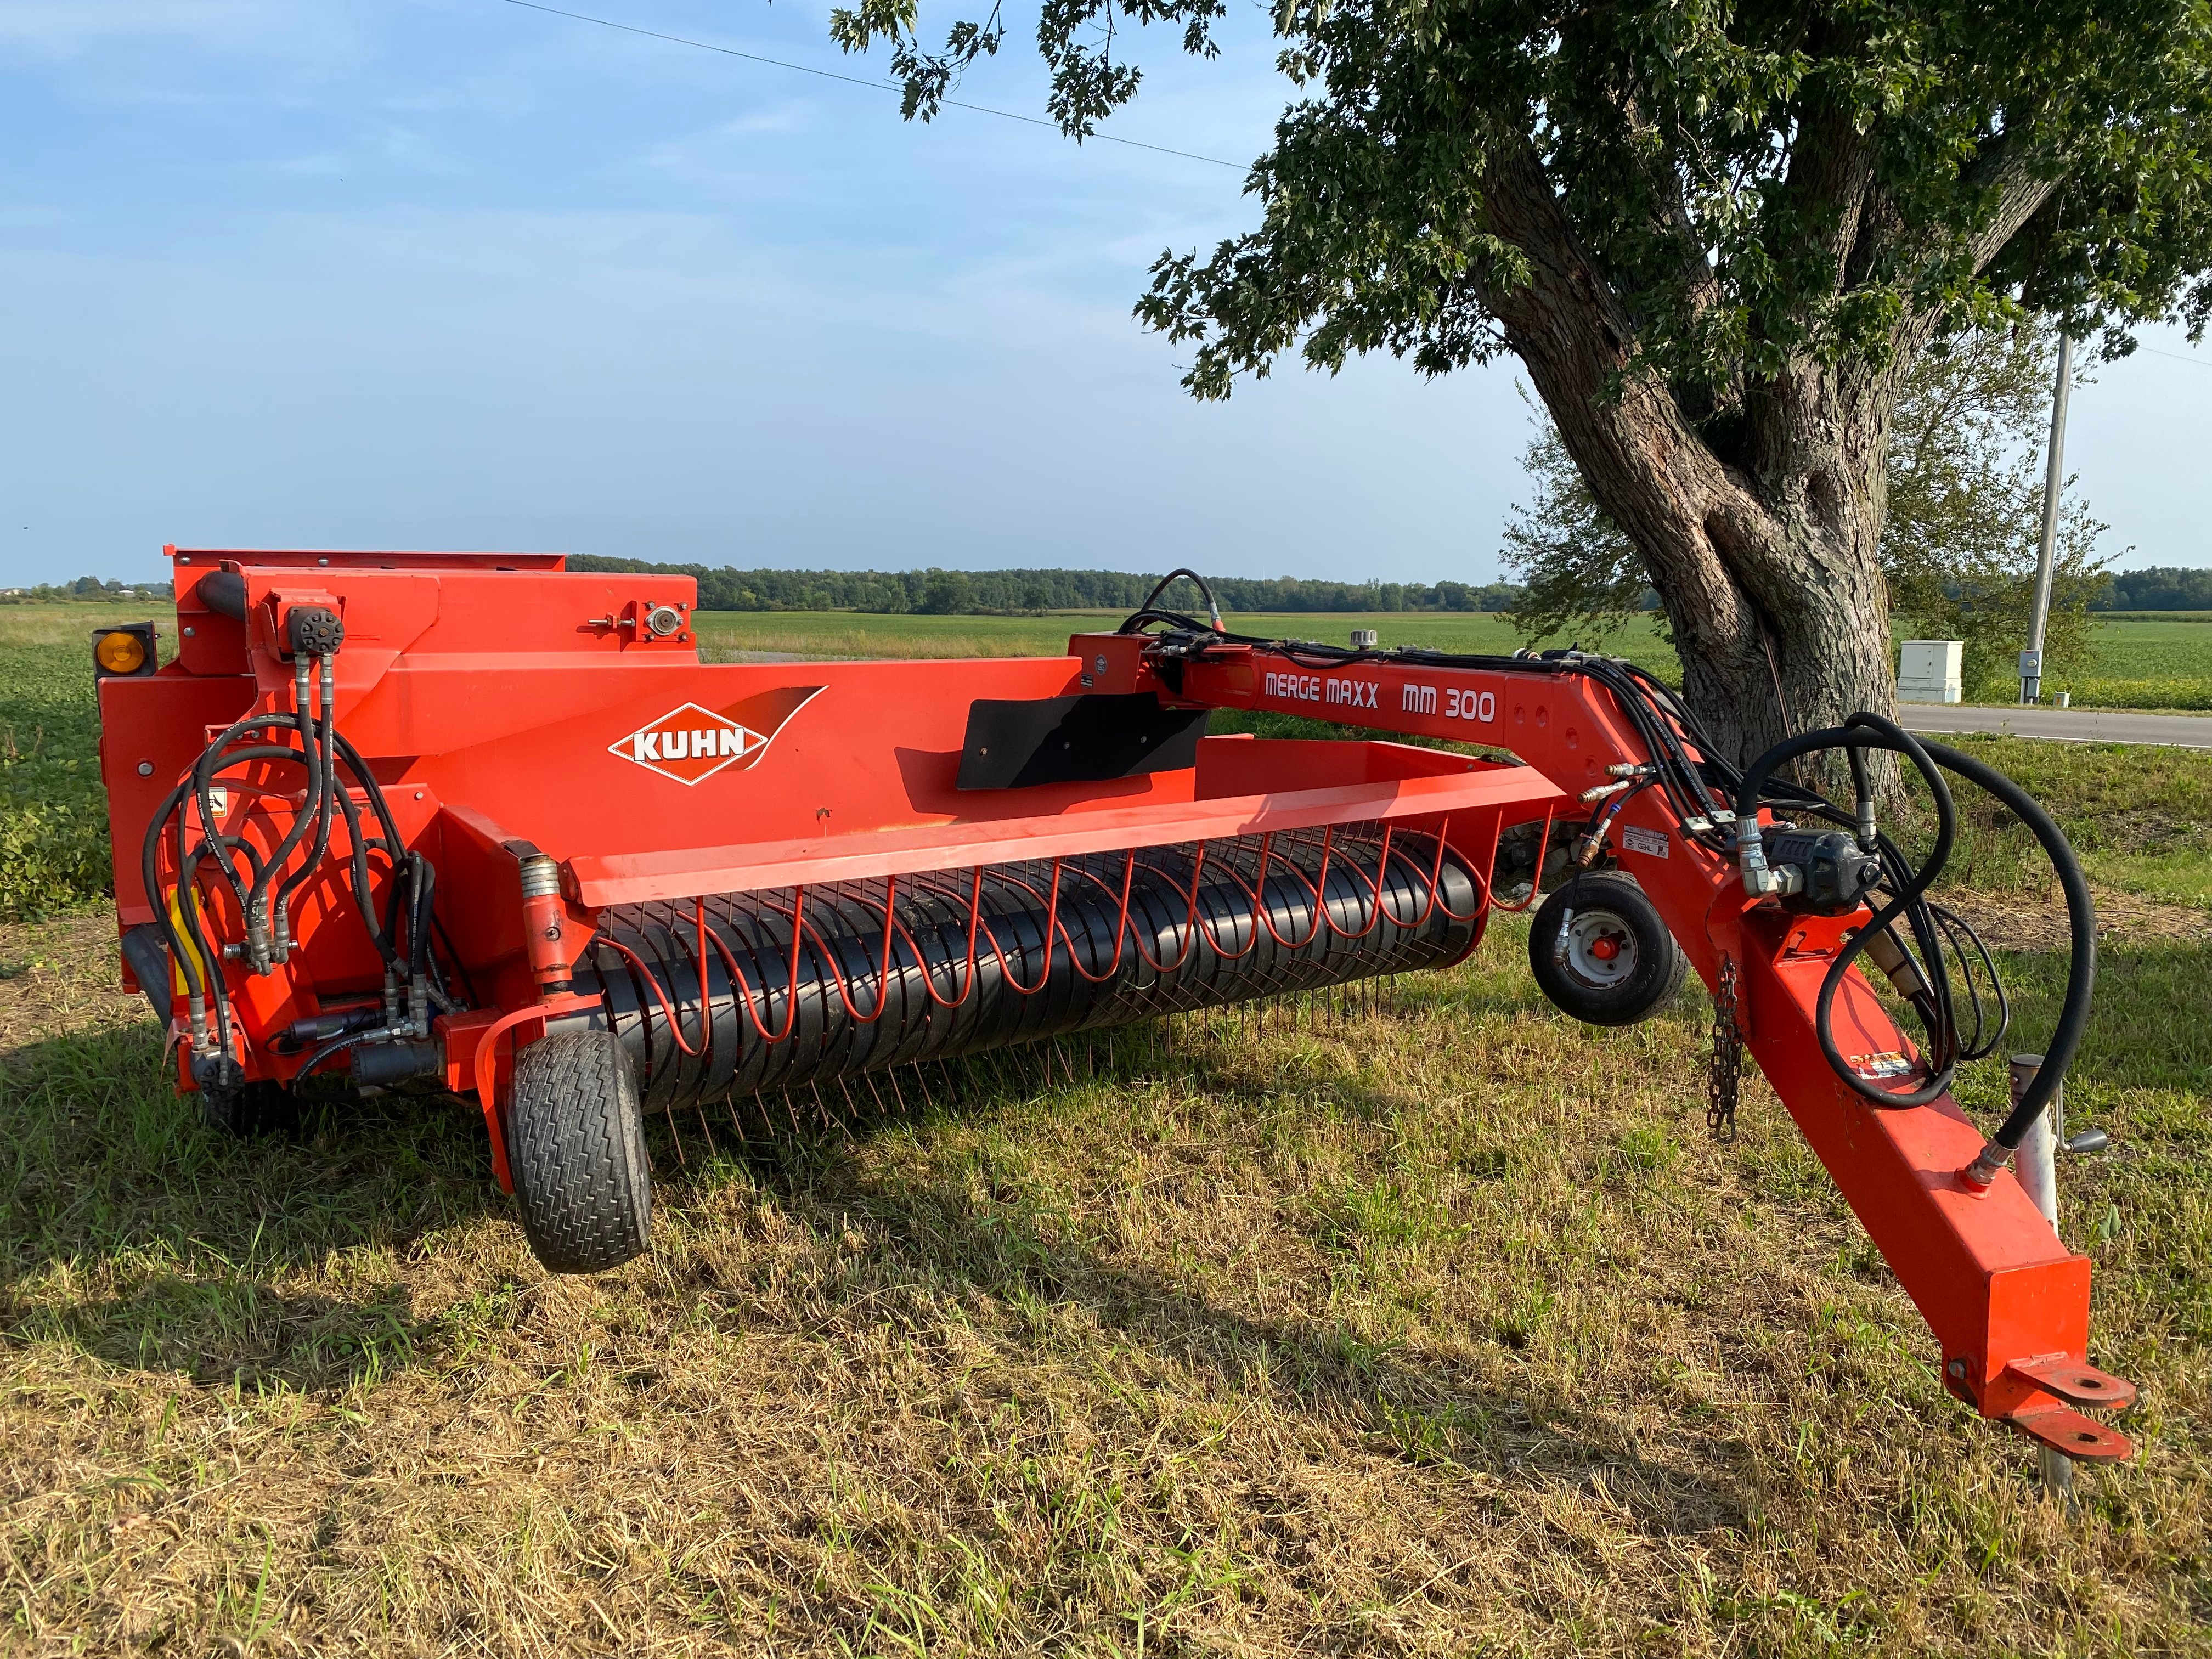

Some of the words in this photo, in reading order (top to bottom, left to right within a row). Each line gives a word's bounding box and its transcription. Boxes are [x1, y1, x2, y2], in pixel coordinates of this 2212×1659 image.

[1265, 672, 1320, 702] MERGE
[1325, 678, 1380, 709] MAXX
[1402, 683, 1438, 715] MM
[1444, 688, 1496, 723] 300
[633, 727, 745, 762] KUHN
